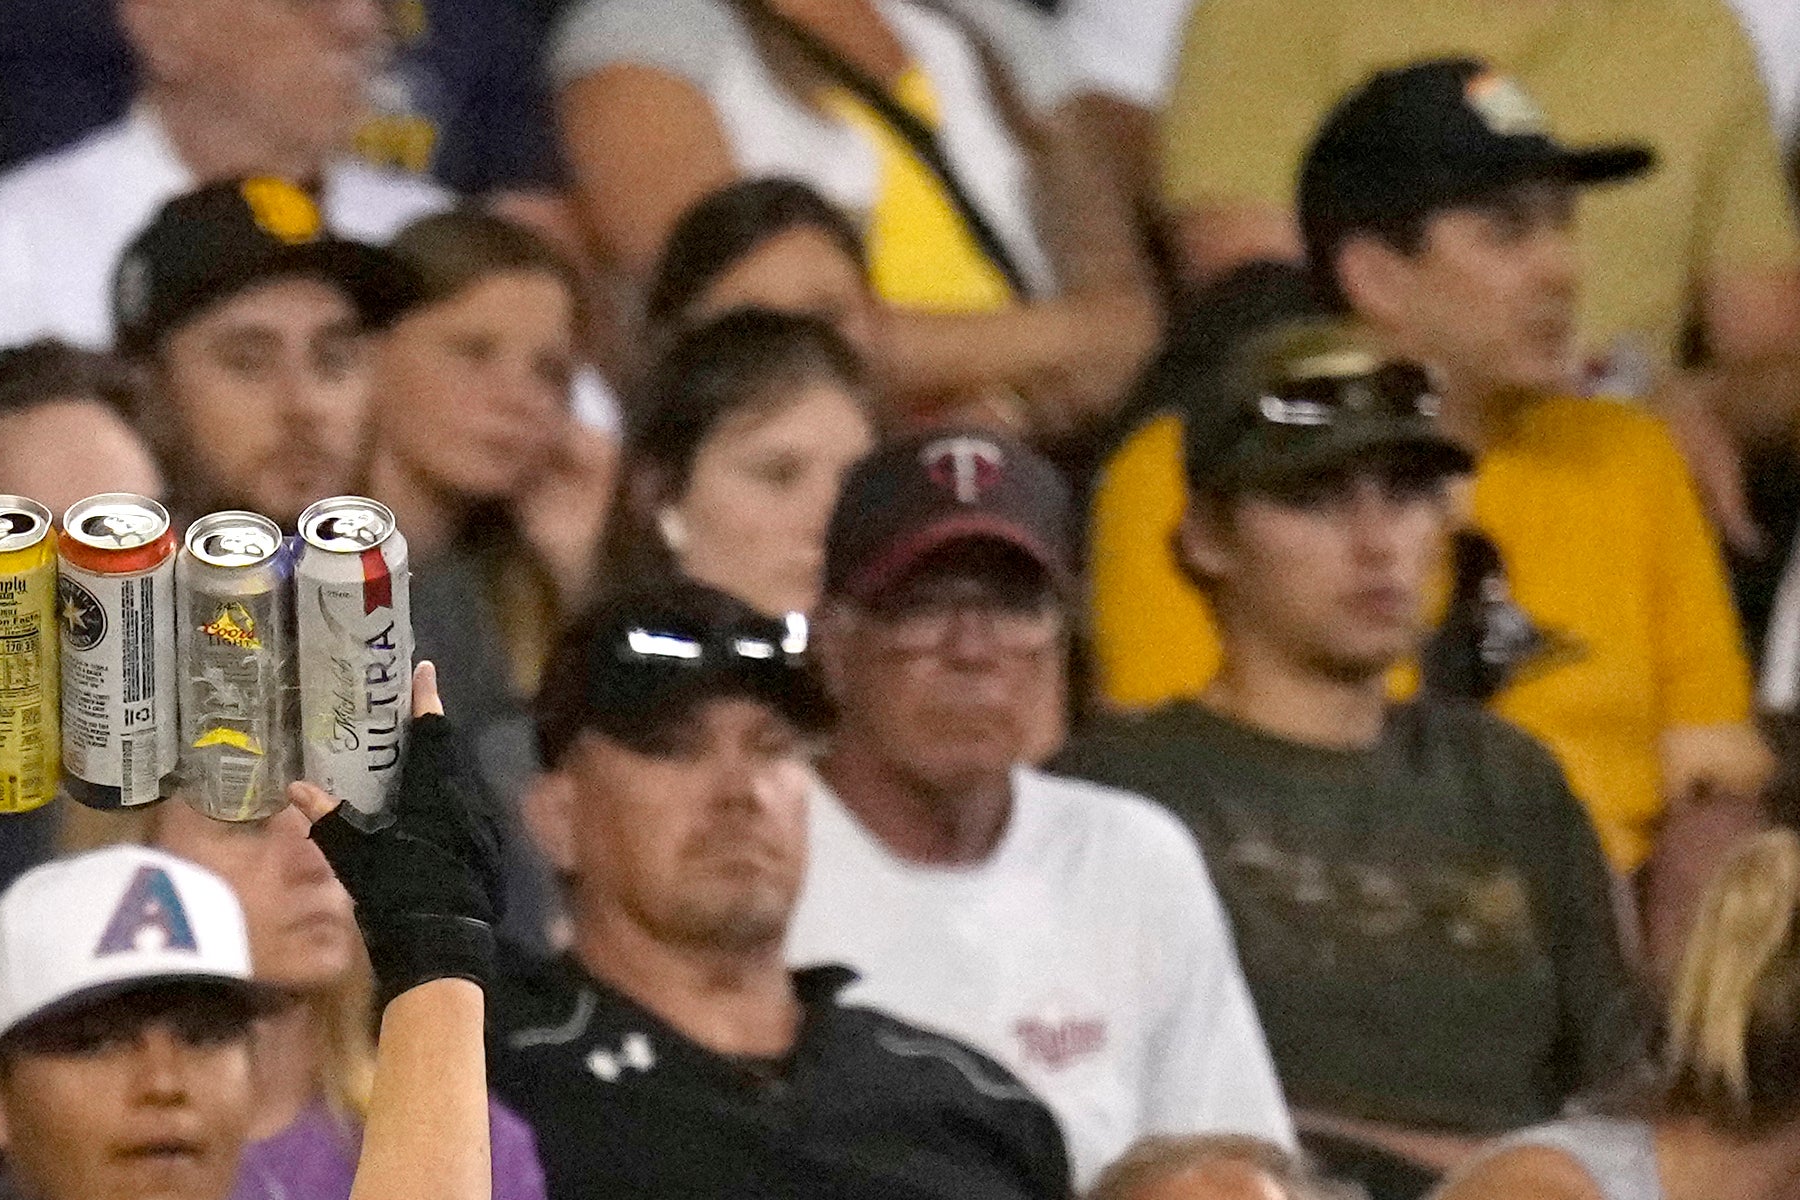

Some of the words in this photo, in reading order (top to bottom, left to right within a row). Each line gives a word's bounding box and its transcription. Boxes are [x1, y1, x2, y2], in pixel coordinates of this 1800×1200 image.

[203, 621, 255, 640] Coors
[366, 621, 399, 772] ULTRA
[96, 866, 199, 958] A
